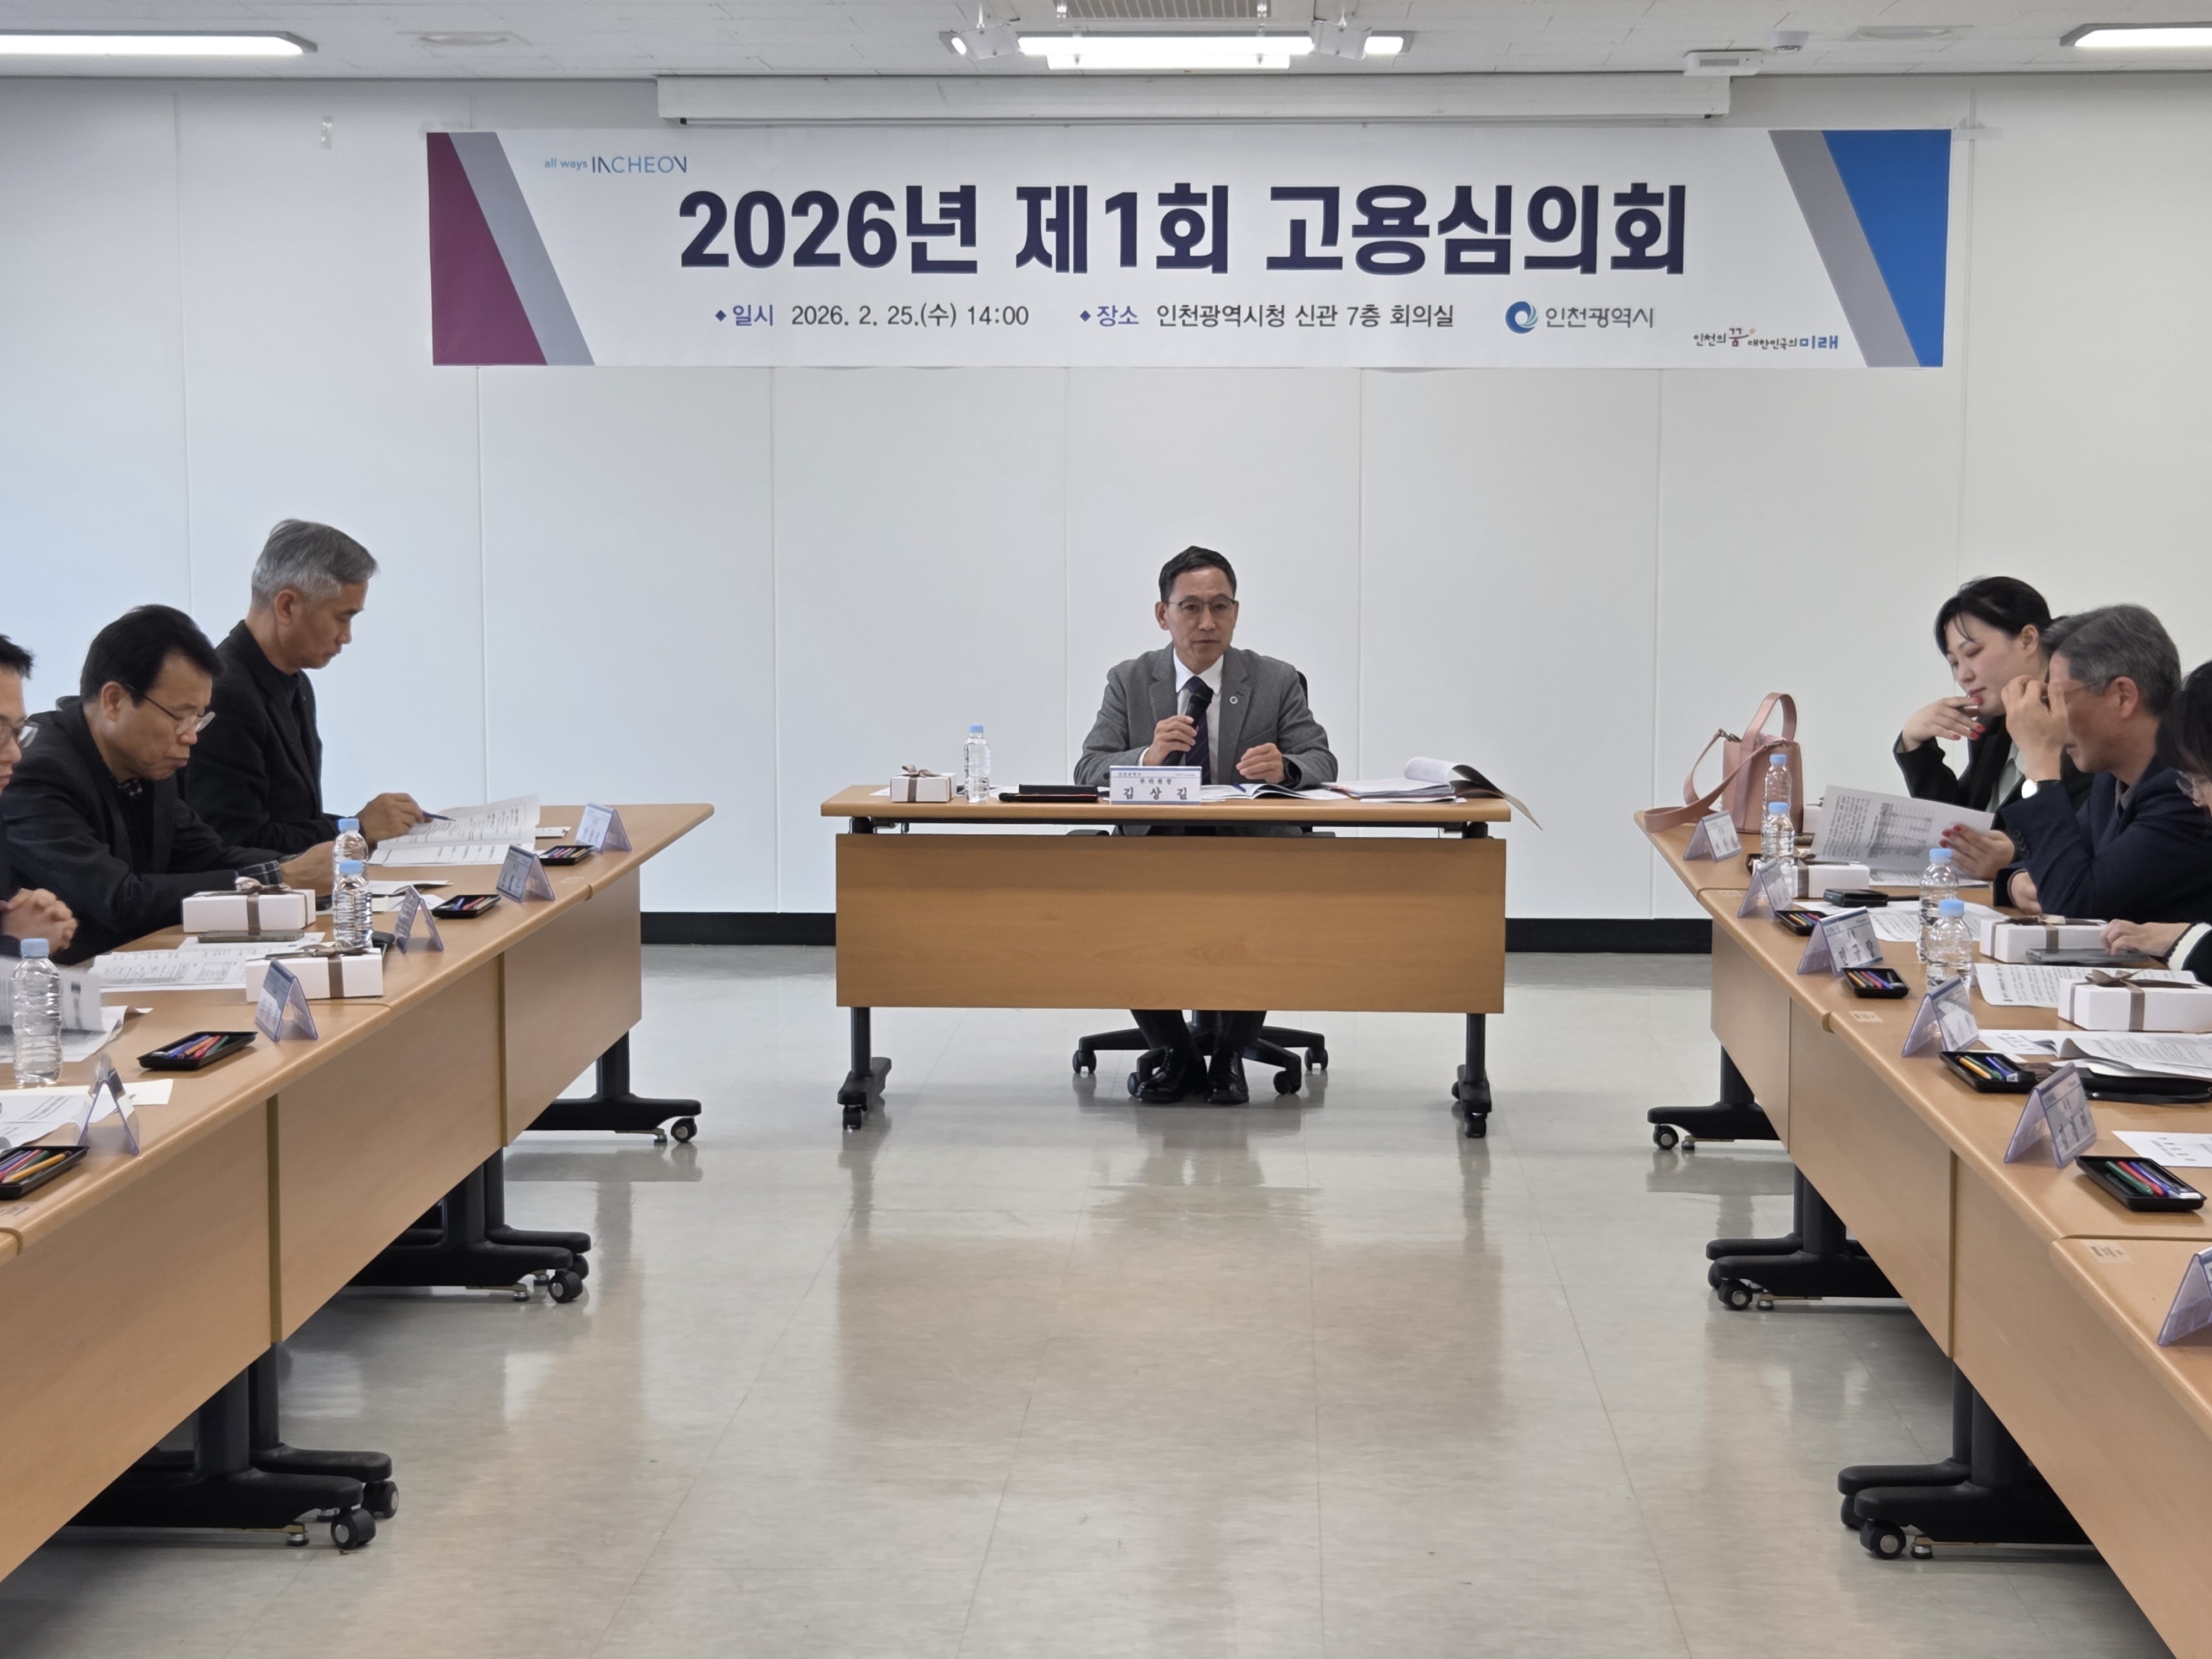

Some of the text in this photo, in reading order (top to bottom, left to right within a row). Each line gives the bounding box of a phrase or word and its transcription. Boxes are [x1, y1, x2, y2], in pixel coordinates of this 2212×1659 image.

[544, 155, 687, 174] all ways INCHEON
[679, 181, 1688, 276] 2026년 제1회 고용심의회
[732, 303, 774, 327] 일시
[791, 302, 1029, 328] 2026. 2. 25.(수) 14:00
[1096, 305, 1140, 327] 장소
[1157, 304, 1454, 328] 인천광역시청 신관 7층 회의실
[1545, 307, 1654, 329] 인천광역시
[1693, 327, 1839, 351] 인천의 꿈 대한민국의 미래
